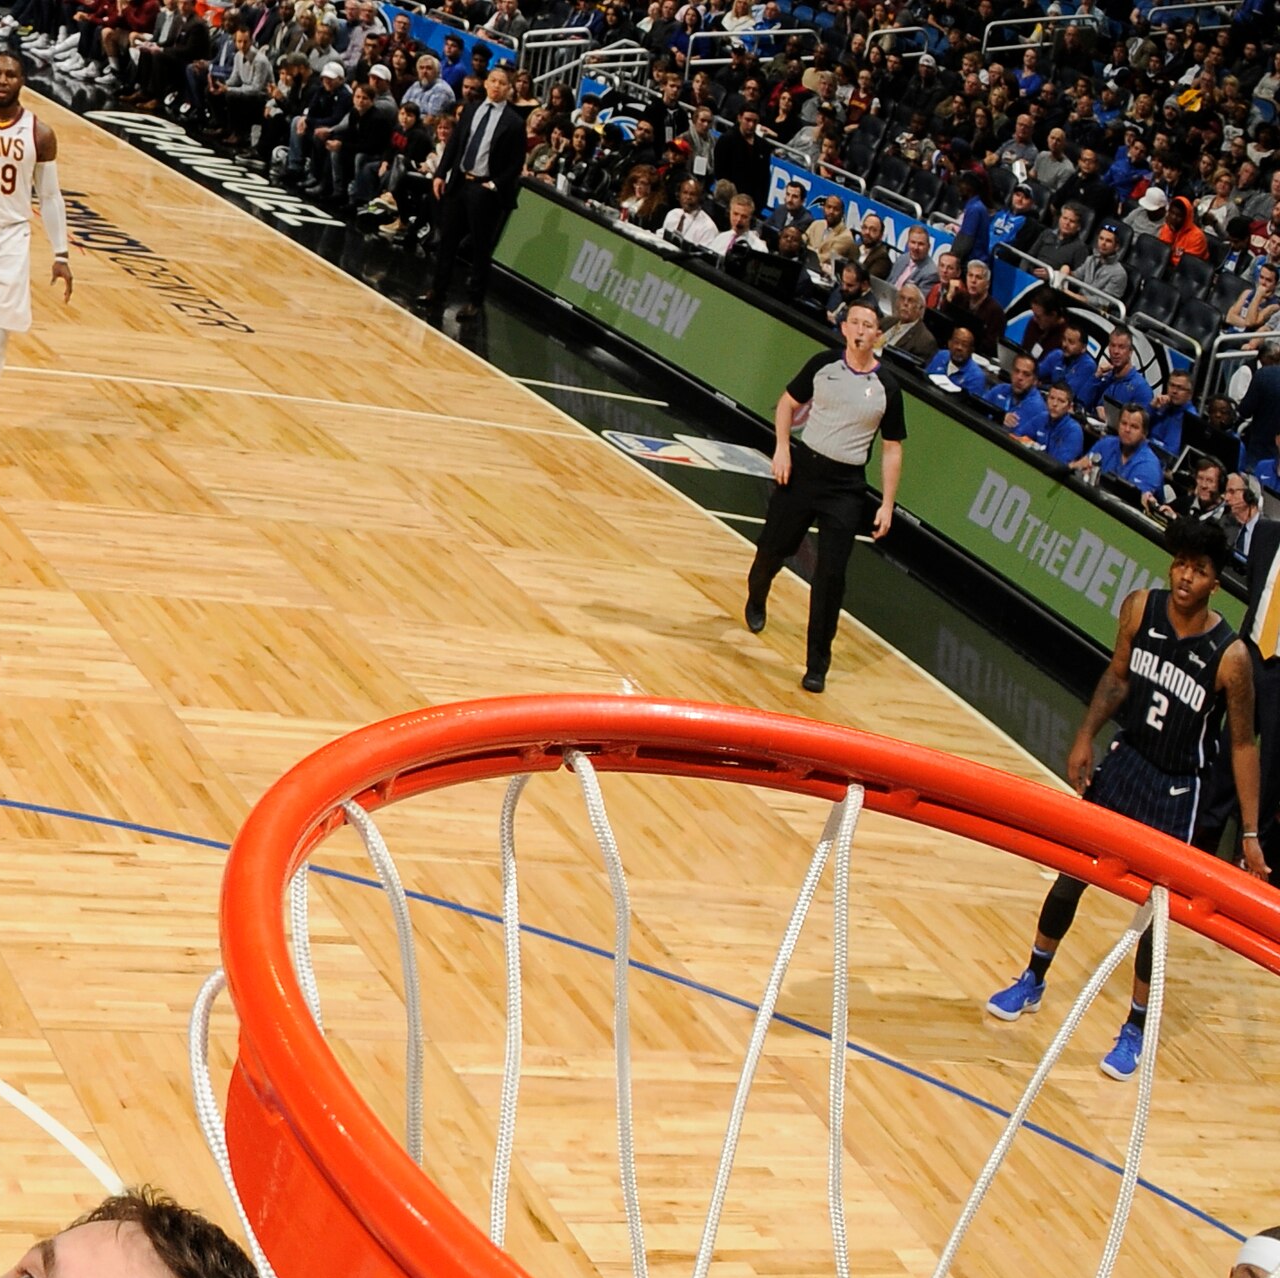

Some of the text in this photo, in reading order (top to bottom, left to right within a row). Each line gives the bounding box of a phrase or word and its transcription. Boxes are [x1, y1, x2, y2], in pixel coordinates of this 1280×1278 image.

[108, 255, 256, 334] CENTER
[570, 238, 614, 292] DO
[603, 268, 641, 312] THE
[630, 271, 702, 340] DEW
[968, 467, 1031, 544] DO
[1016, 512, 1074, 577] THE
[1129, 646, 1207, 713] ORLANDO
[1145, 690, 1169, 732] 2
